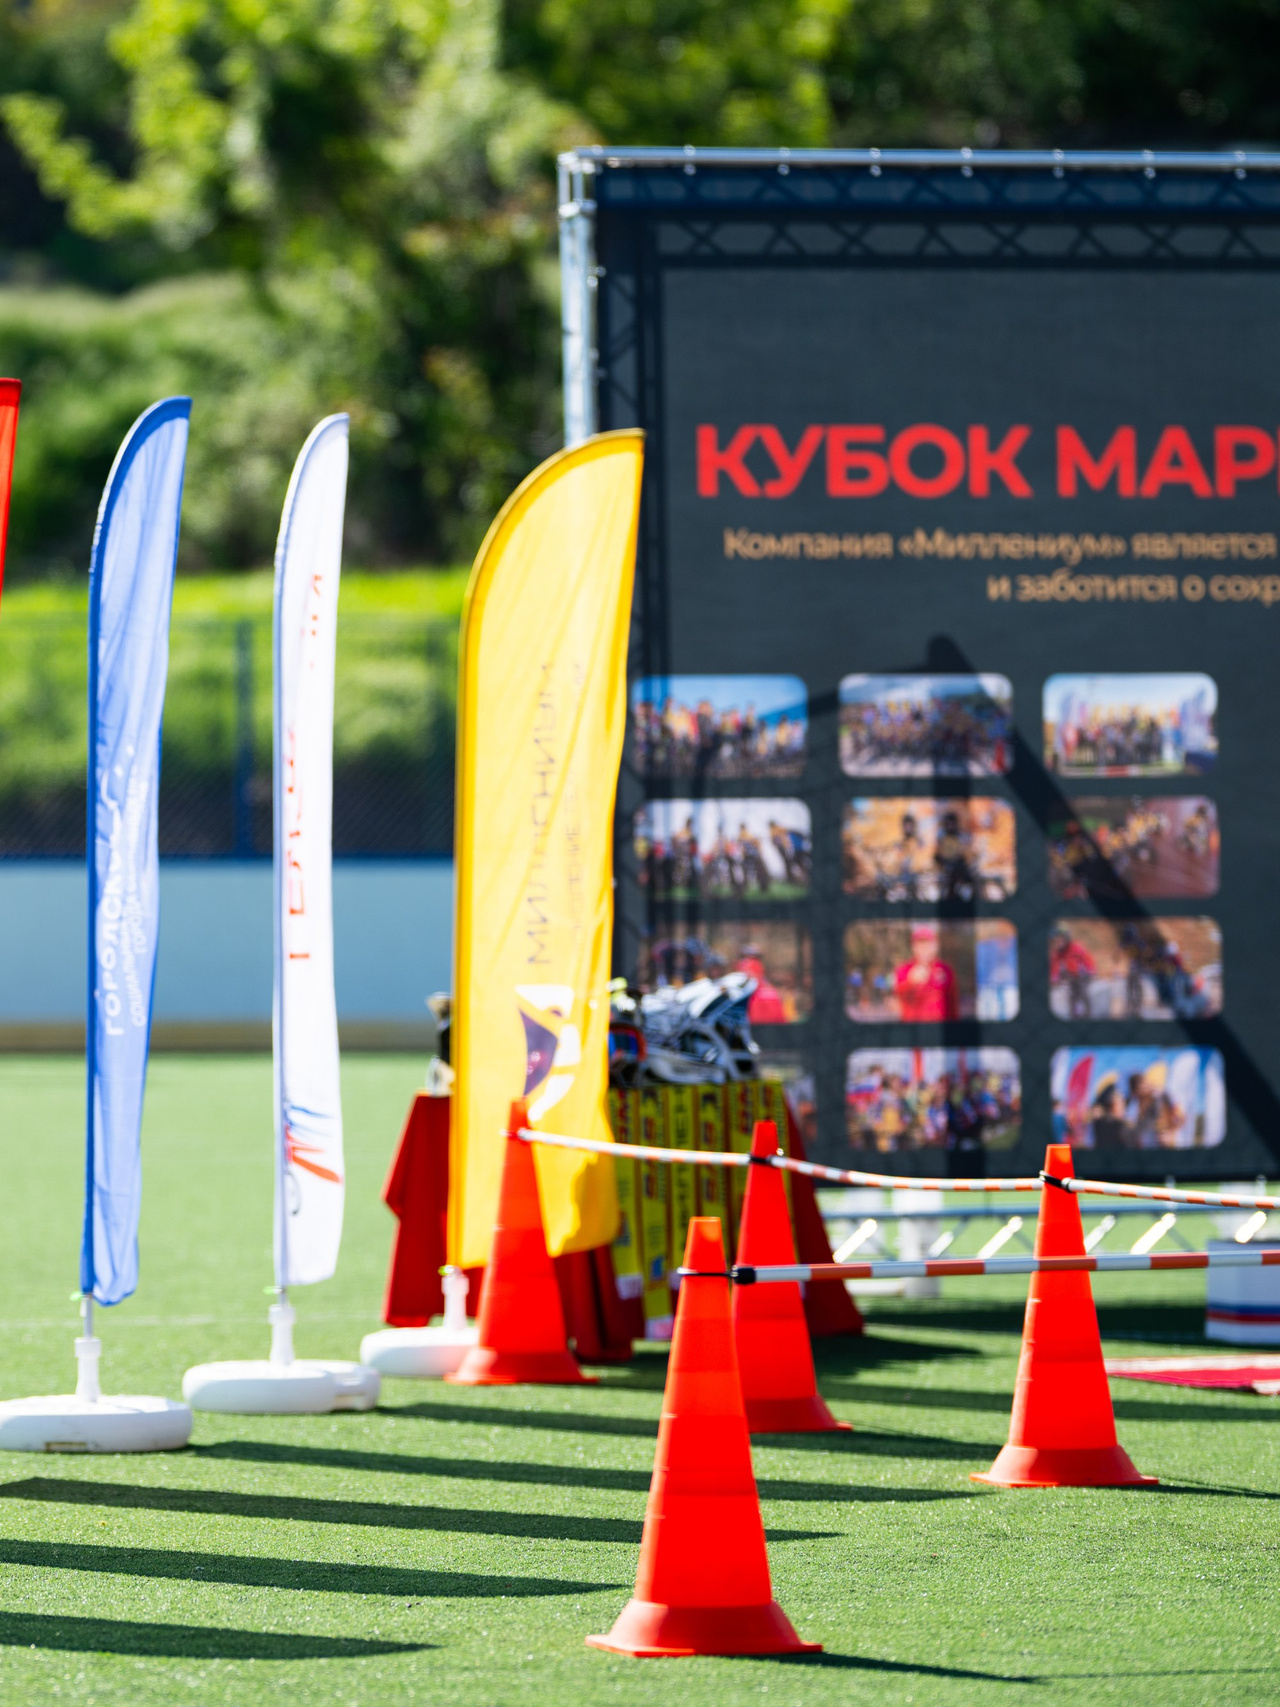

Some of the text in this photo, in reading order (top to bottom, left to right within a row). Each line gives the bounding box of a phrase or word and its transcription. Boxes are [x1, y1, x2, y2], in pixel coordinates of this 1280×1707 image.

[697, 423, 1280, 498] КУБОК МАР
[723, 527, 892, 560] Компания
[1131, 532, 1277, 561] является
[986, 567, 1280, 608] и заботится о сохр
